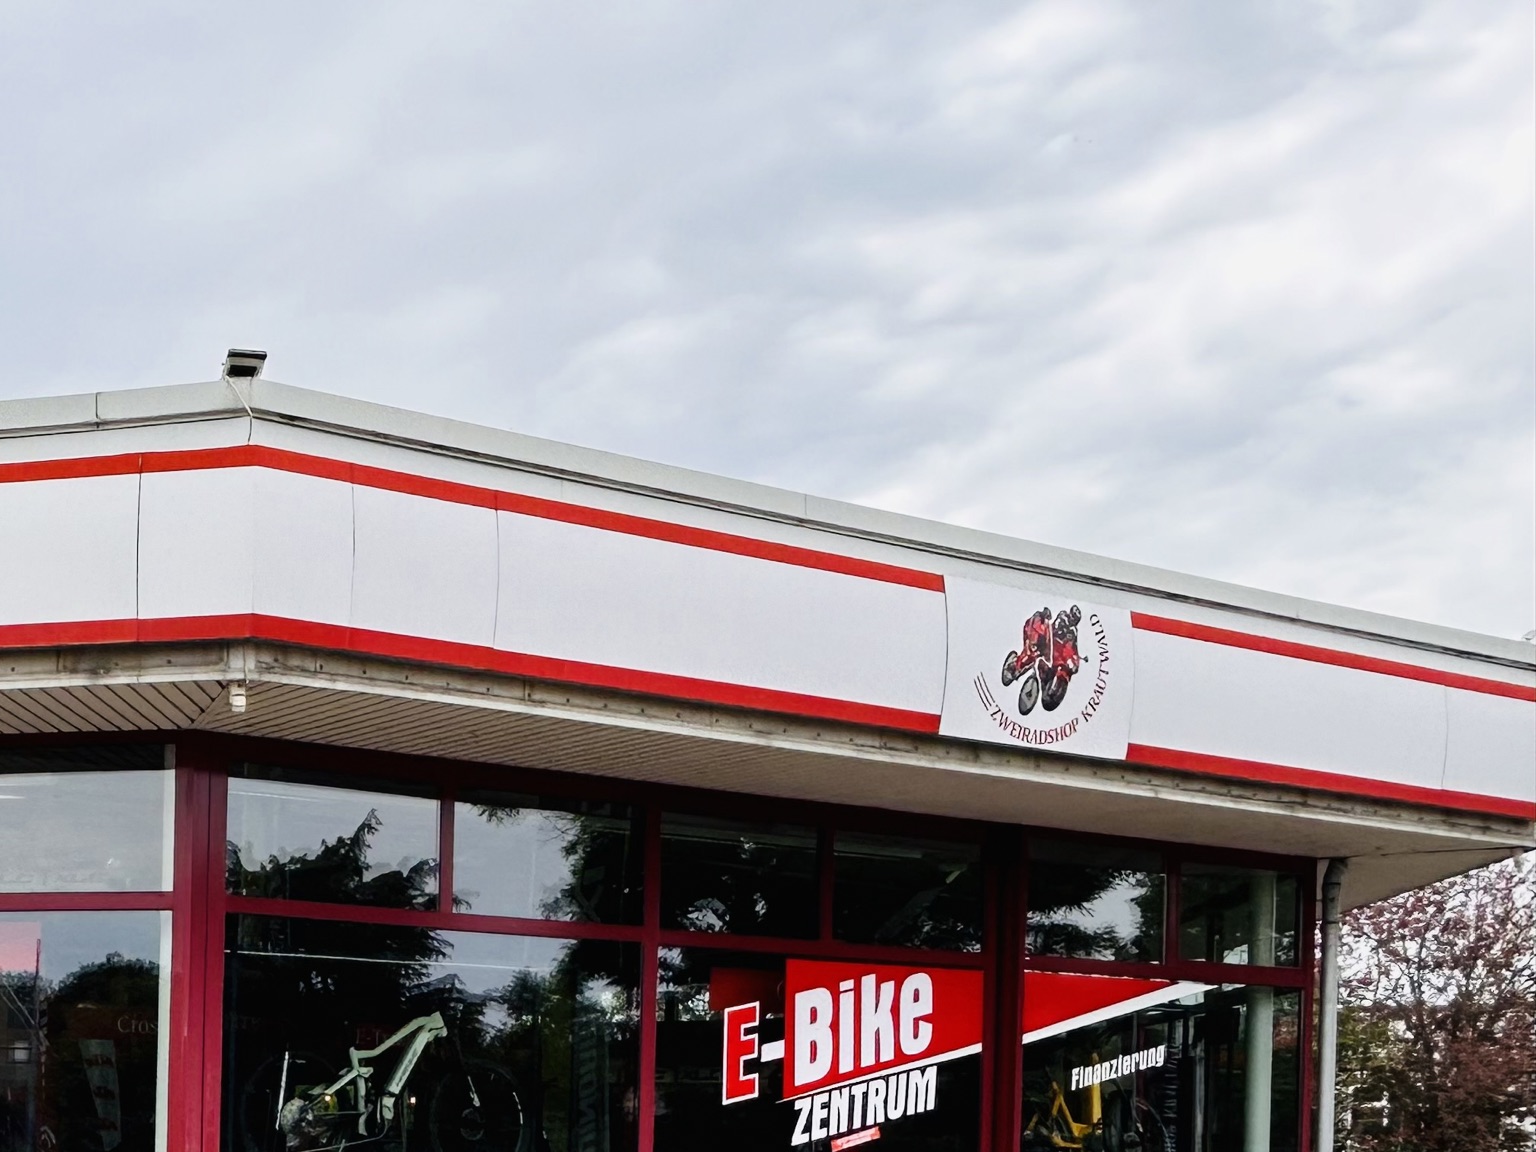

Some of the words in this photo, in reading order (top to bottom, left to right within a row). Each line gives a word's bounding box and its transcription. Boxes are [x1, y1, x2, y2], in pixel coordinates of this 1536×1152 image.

[990, 704, 1080, 745] ZWEIRADSHOP
[1081, 613, 1110, 723] KRAUTWALD
[722, 972, 934, 1106] E-Bike
[1071, 1044, 1166, 1091] Finanzierung
[791, 1065, 938, 1146] ZENTRUM
